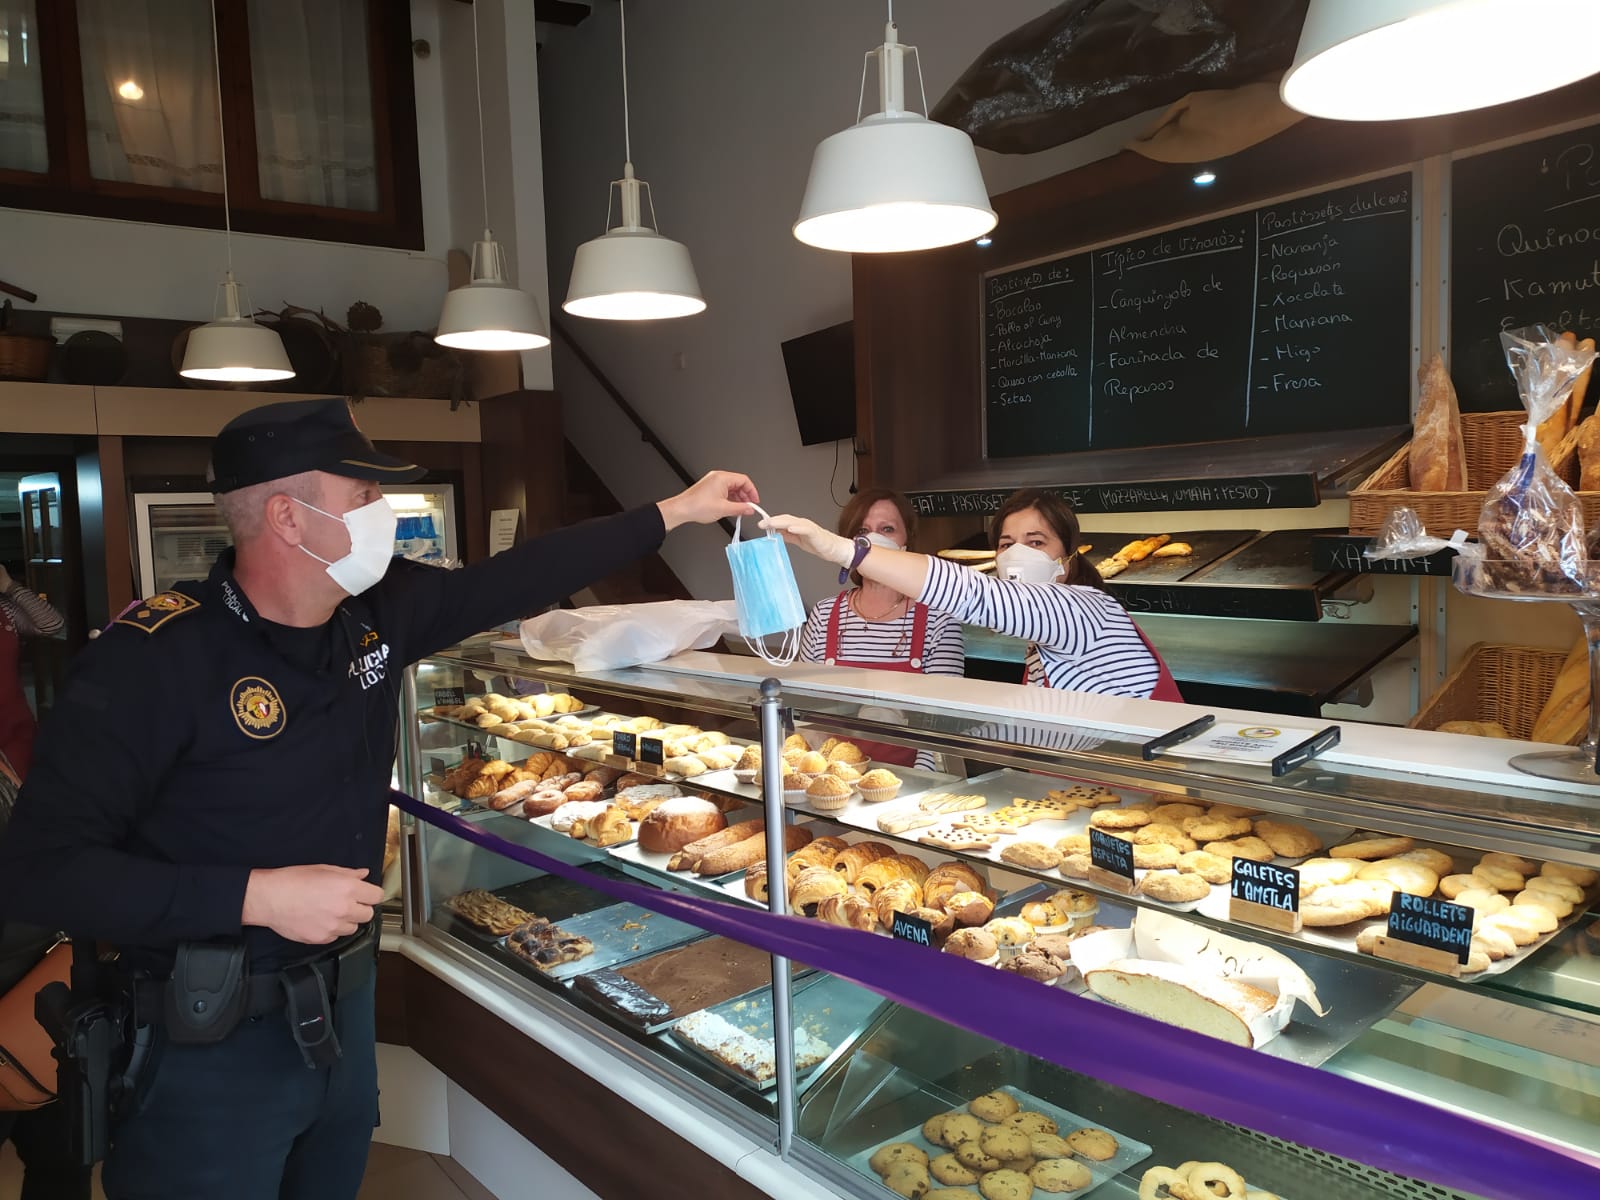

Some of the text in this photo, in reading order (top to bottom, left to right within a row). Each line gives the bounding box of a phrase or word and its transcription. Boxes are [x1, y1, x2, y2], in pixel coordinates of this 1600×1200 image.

[1152, 238, 1173, 256] de
[1271, 233, 1340, 260] Naranja
[1202, 272, 1224, 293] de
[995, 297, 1042, 320] Bacalao
[995, 321, 1021, 336] Pollo
[1023, 316, 1034, 330] al
[1109, 320, 1188, 345] Almendra
[1274, 311, 1353, 333] Manzana
[997, 333, 1053, 353] Alcachofa
[1275, 343, 1321, 363] Higo
[1109, 341, 1221, 369] Farinada de
[1027, 374, 1043, 384] con
[1046, 363, 1078, 380] cebolla
[1272, 372, 1322, 393] Fresa
[999, 392, 1032, 407] Setas
[1233, 859, 1295, 890] GALETES
[1231, 879, 1293, 912] d'AMETLA
[1400, 893, 1468, 922] ROLLETS
[893, 919, 929, 947] AVENA
